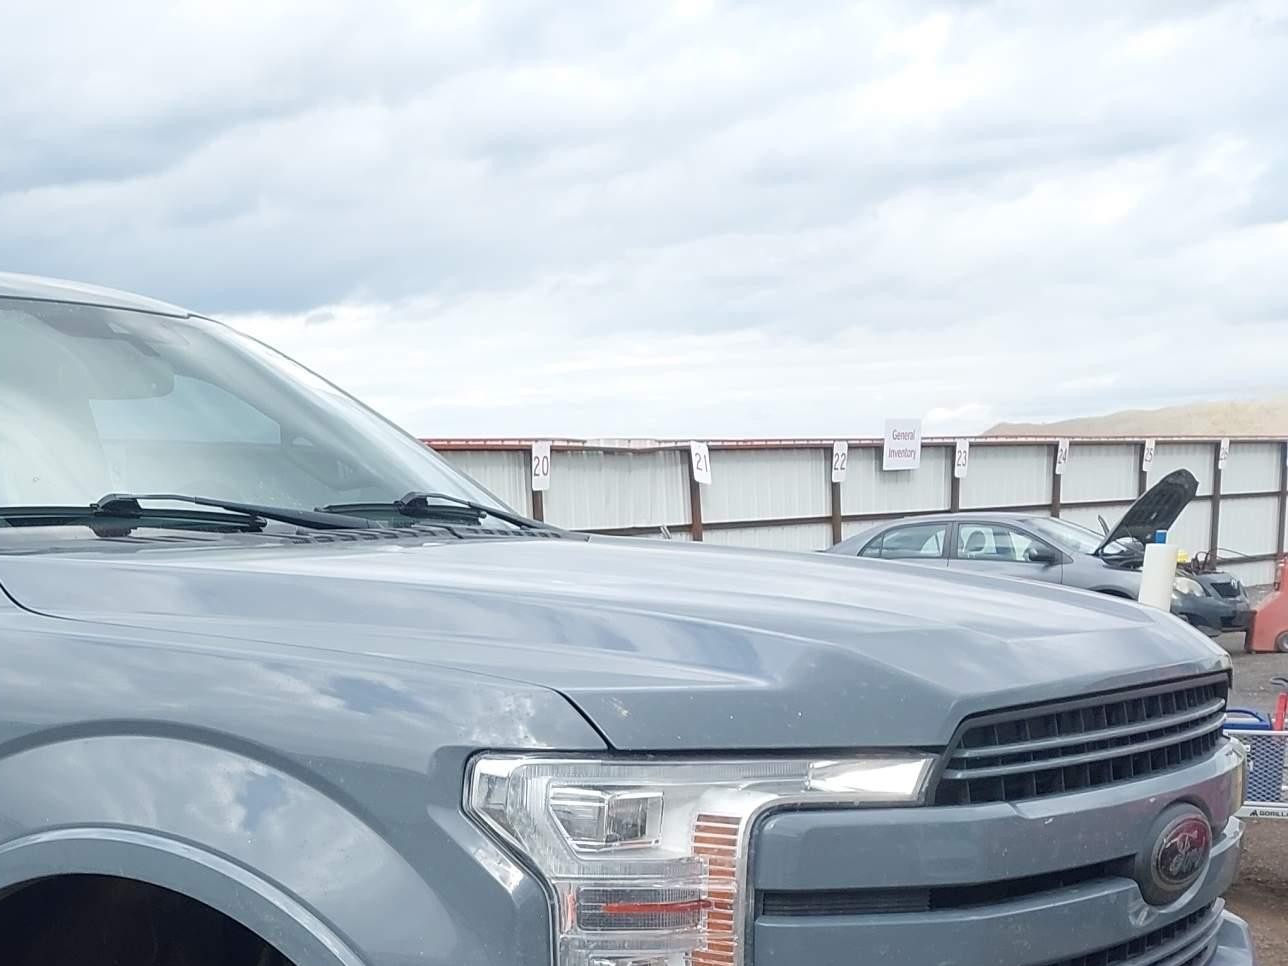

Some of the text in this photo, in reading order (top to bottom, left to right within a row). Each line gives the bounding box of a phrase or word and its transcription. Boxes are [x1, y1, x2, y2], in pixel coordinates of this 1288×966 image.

[892, 430, 915, 440] General
[834, 453, 846, 470] 22
[888, 448, 916, 460] Inventory
[957, 450, 967, 467] 23
[533, 456, 549, 477] 20
[694, 453, 709, 473] 21
